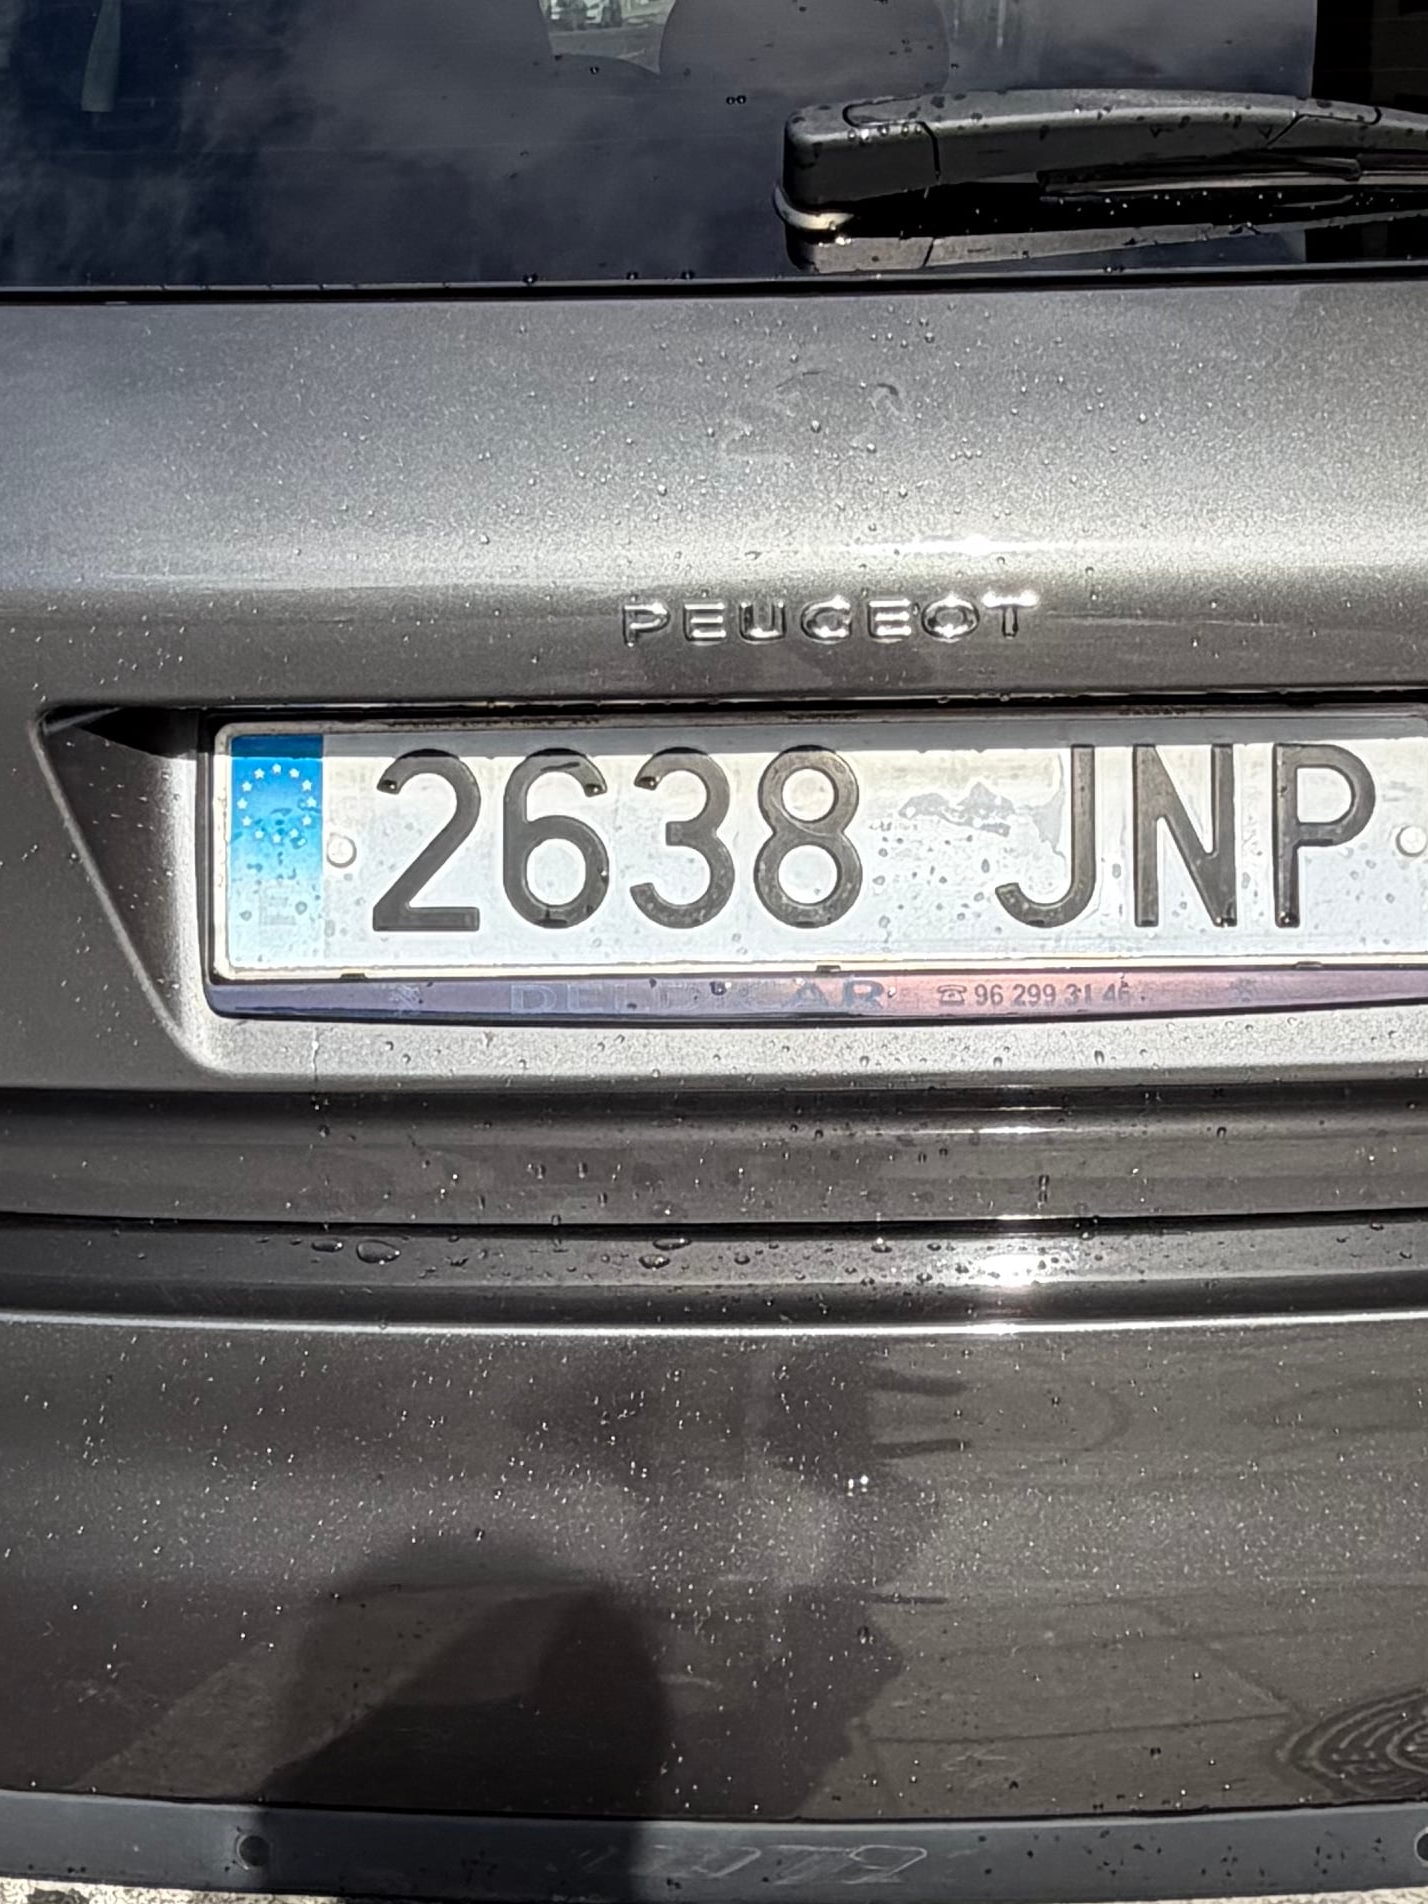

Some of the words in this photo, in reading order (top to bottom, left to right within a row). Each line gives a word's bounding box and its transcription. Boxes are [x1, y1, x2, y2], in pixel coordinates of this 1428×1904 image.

[622, 592, 1039, 649] PEUGEOT
[372, 746, 863, 930] 2638
[995, 743, 1375, 929] JNP
